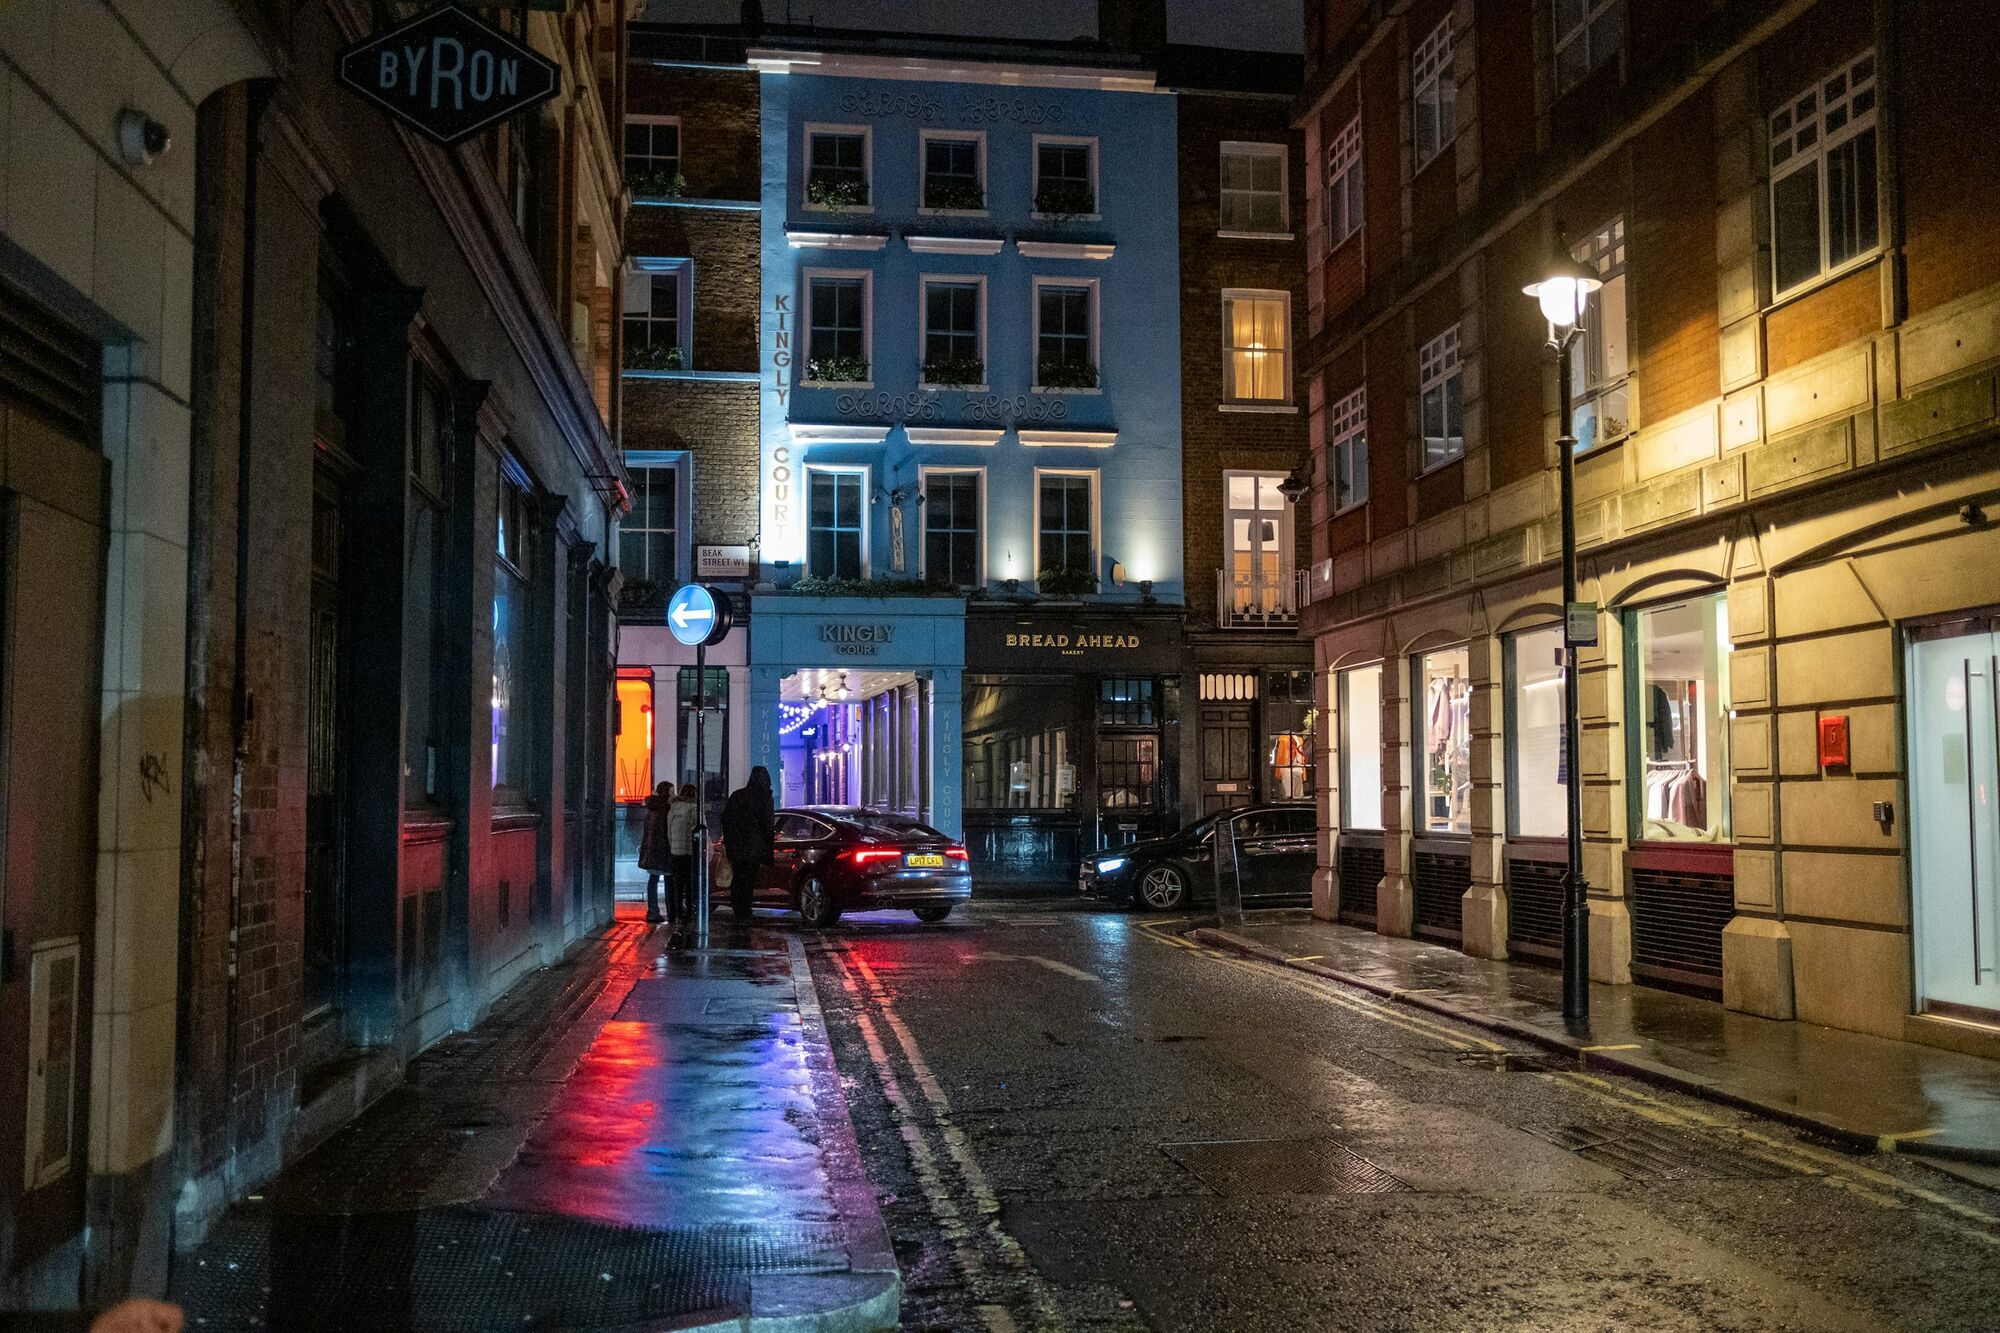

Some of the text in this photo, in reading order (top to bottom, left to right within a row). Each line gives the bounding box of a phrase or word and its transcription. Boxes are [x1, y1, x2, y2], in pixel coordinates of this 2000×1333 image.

[378, 36, 519, 111] BYRON
[772, 294, 791, 540] KINGLY COURT
[702, 548, 723, 557] BEAK
[702, 558, 745, 567] STREET W1
[821, 624, 896, 642] KINGLY
[1005, 633, 1140, 648] BREAD AHEAD
[838, 644, 880, 656] COURT
[761, 709, 771, 766] KINGL
[943, 710, 952, 777] KINGLY
